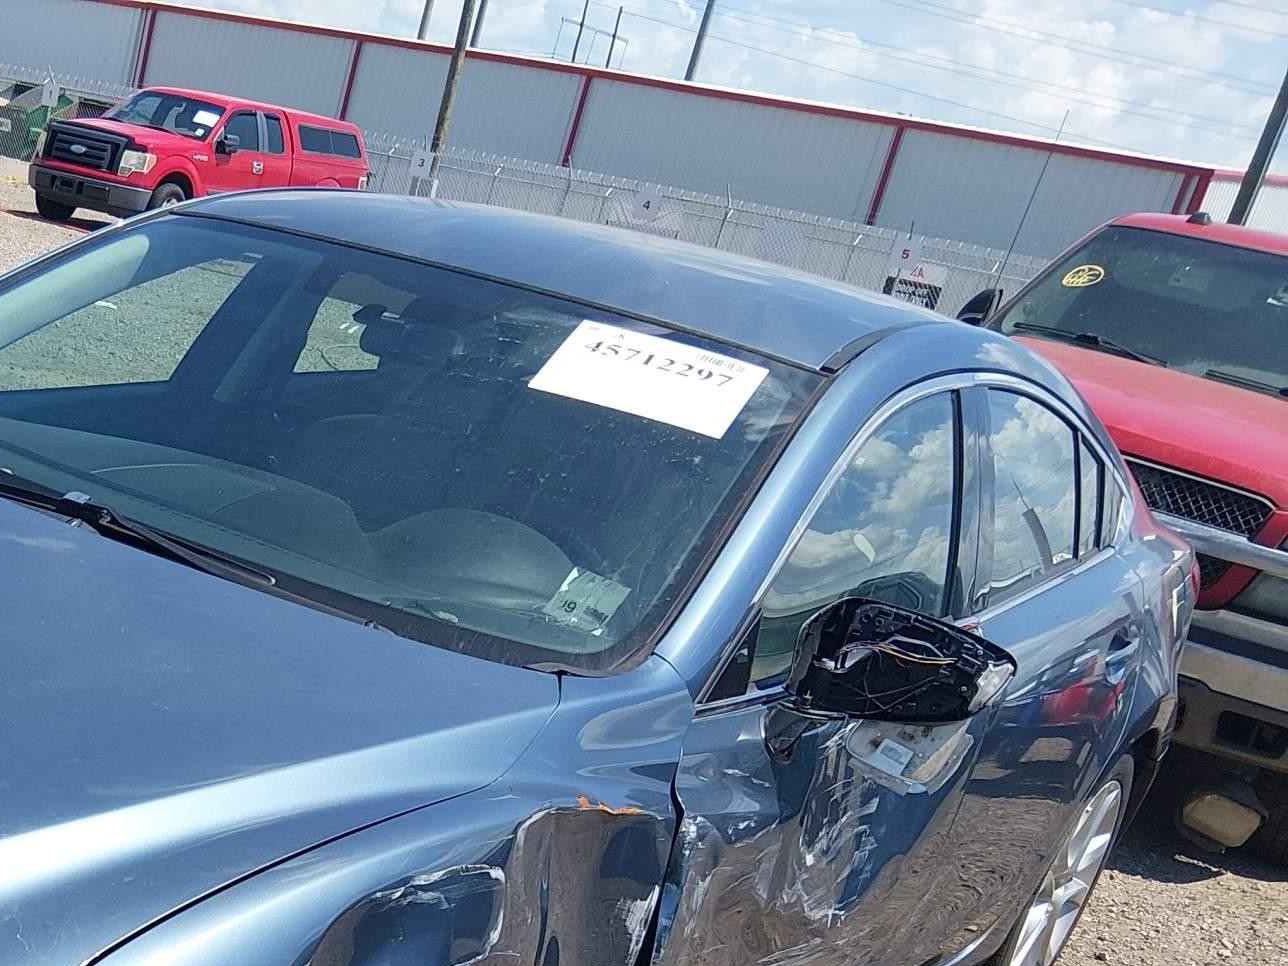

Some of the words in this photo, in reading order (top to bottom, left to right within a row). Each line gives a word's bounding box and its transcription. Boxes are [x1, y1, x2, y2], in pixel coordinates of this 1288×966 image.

[418, 158, 425, 167] 3
[642, 200, 651, 210] 4
[902, 249, 911, 259] 5
[584, 341, 734, 387] 45712297
